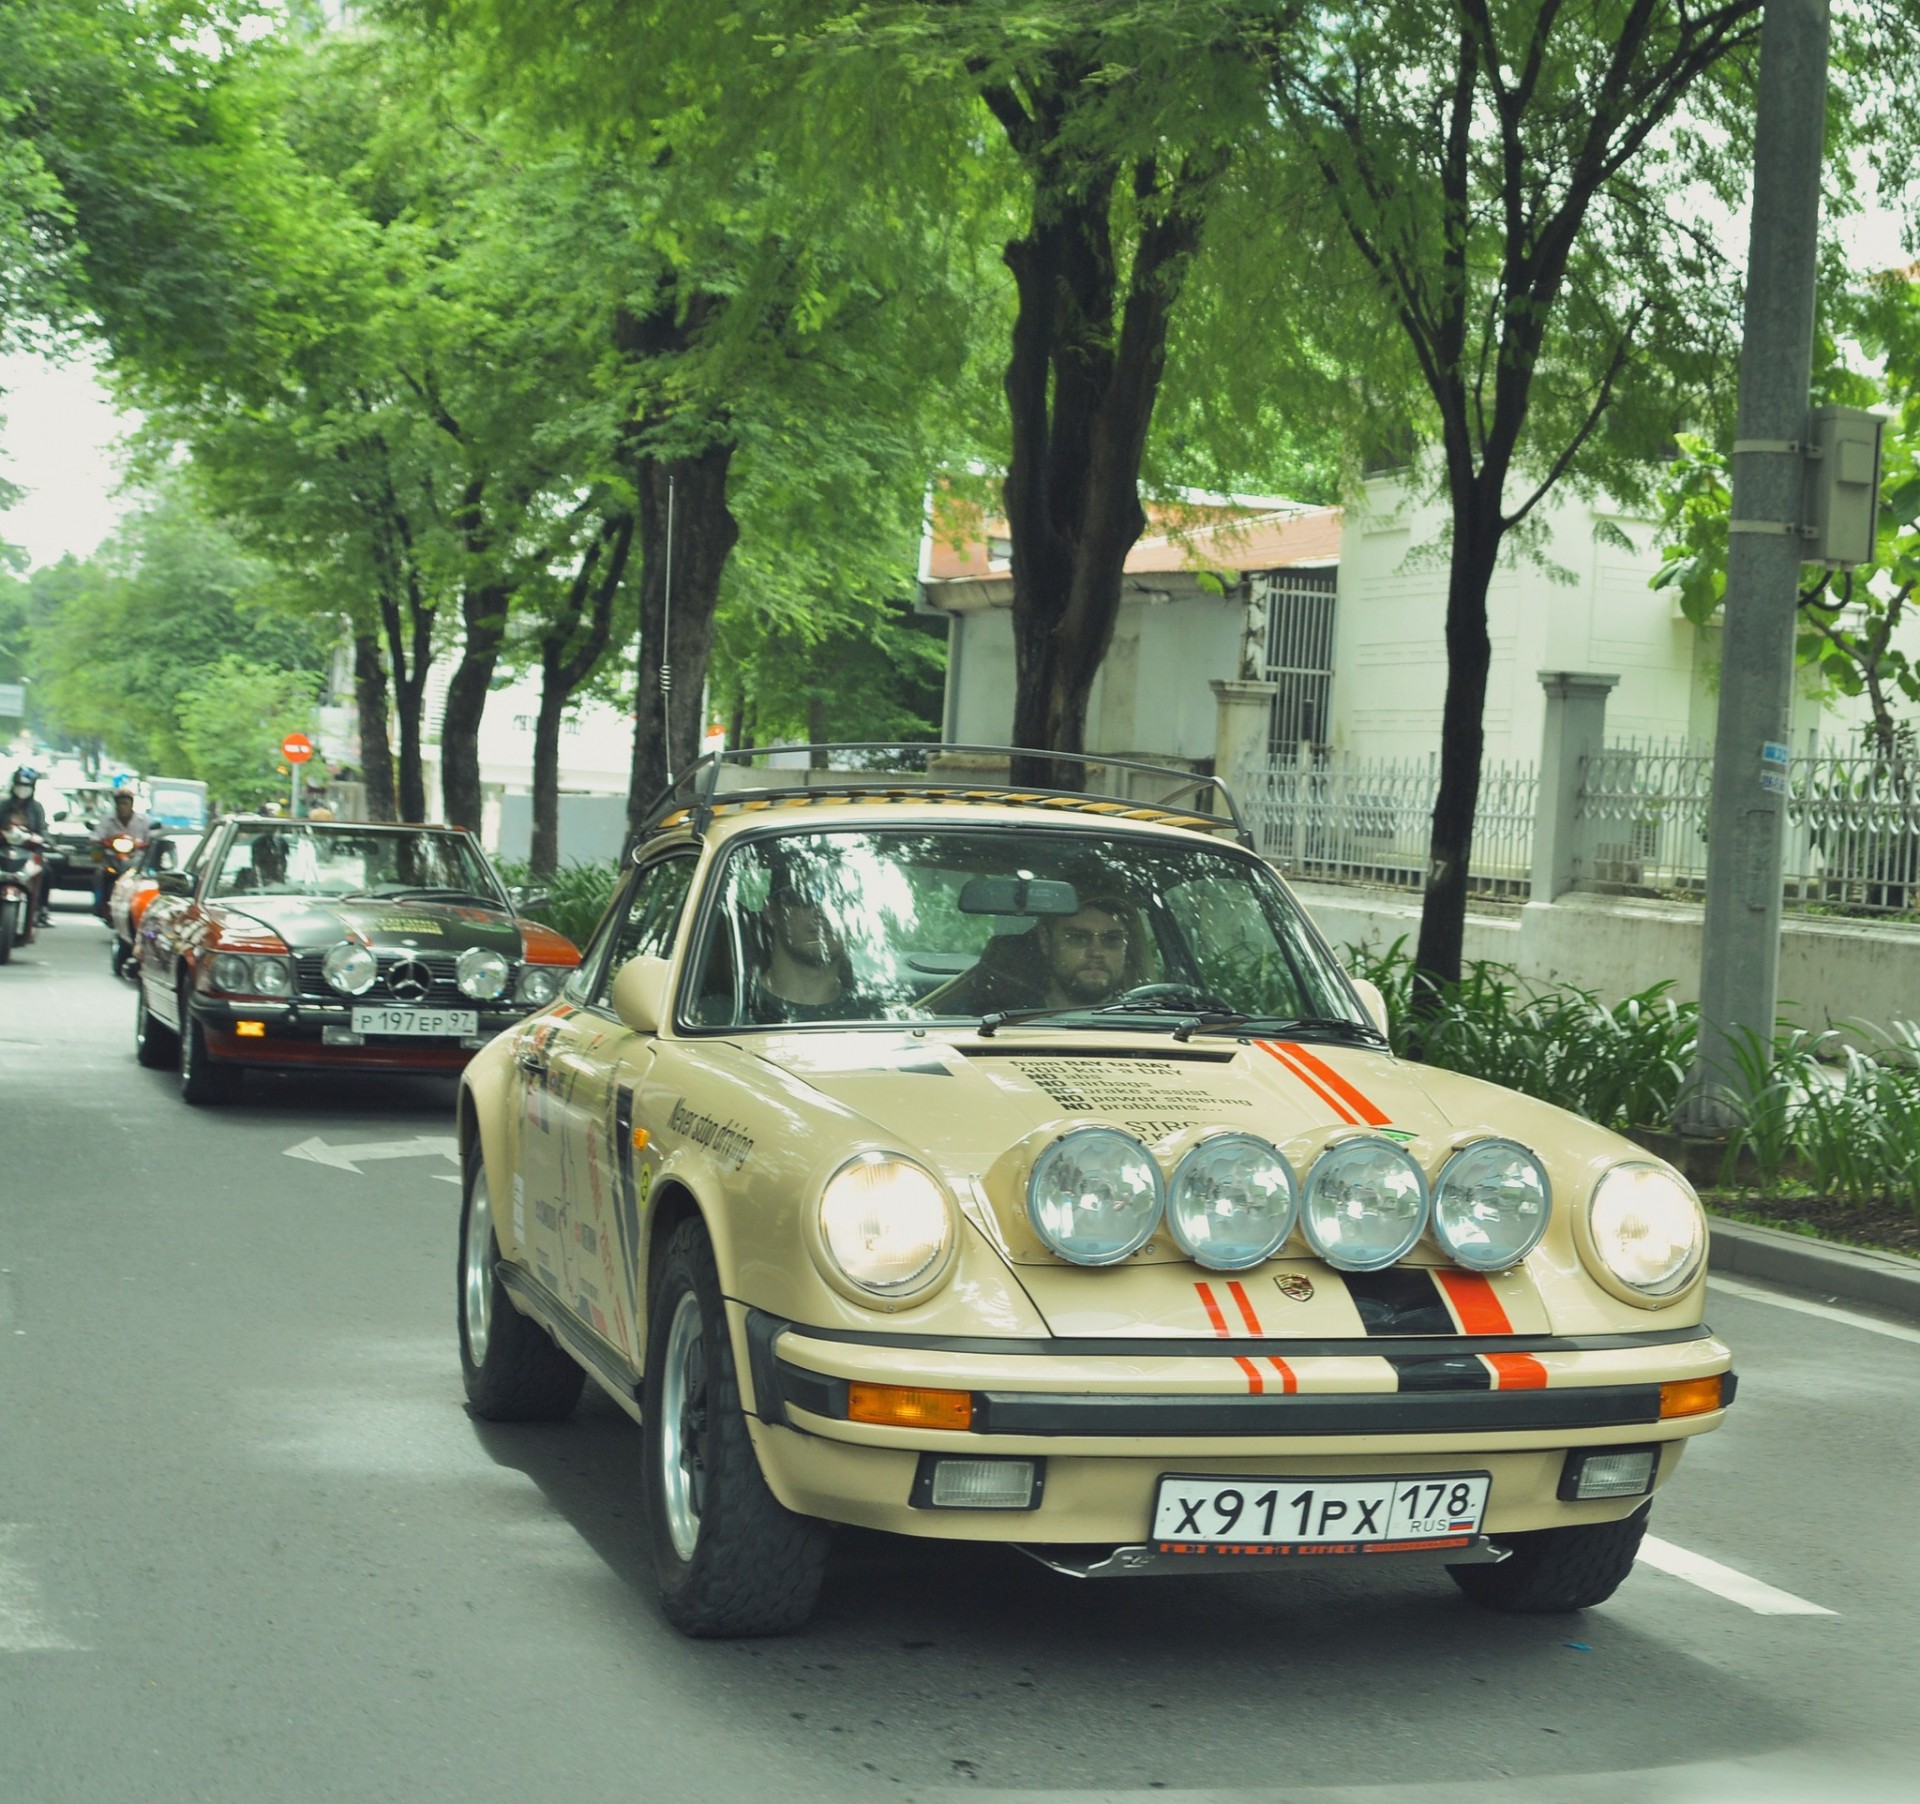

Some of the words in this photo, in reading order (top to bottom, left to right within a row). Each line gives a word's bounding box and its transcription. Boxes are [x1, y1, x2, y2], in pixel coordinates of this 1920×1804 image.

[450, 1012, 470, 1028] 97
[1072, 1080, 1153, 1088] airbags
[1080, 1087, 1142, 1095] brake
[1050, 1094, 1086, 1102] NO
[1163, 1096, 1254, 1107] steering
[1060, 1102, 1095, 1111] NO
[667, 1096, 698, 1136] Never
[1399, 1482, 1471, 1520] 178
[1409, 1517, 1448, 1533] RUS
